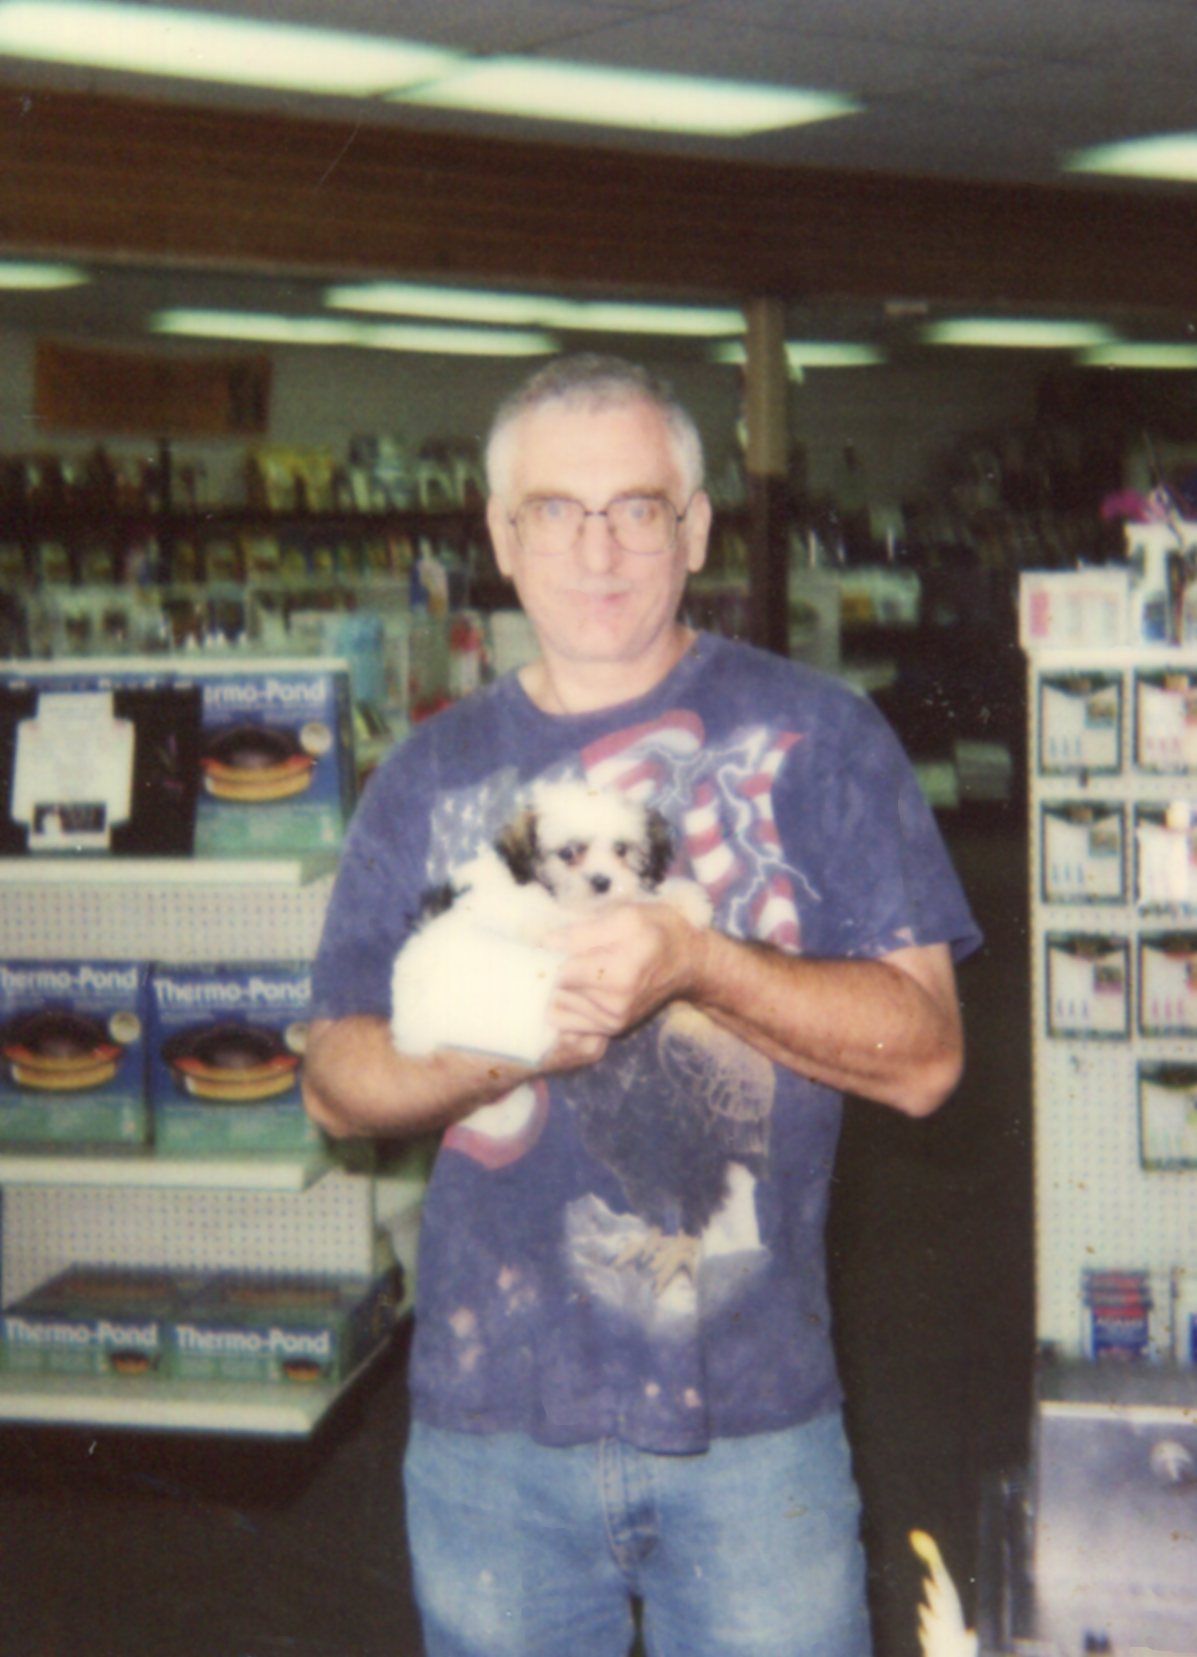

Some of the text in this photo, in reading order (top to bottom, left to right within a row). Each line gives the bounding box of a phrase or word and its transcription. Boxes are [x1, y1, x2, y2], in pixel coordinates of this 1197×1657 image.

[0, 966, 137, 991] hermo-Pond
[153, 978, 312, 1006] Thermo-Pond
[6, 1318, 156, 1345] Thermo-Pond
[176, 1325, 329, 1353] Thermo-Pond
